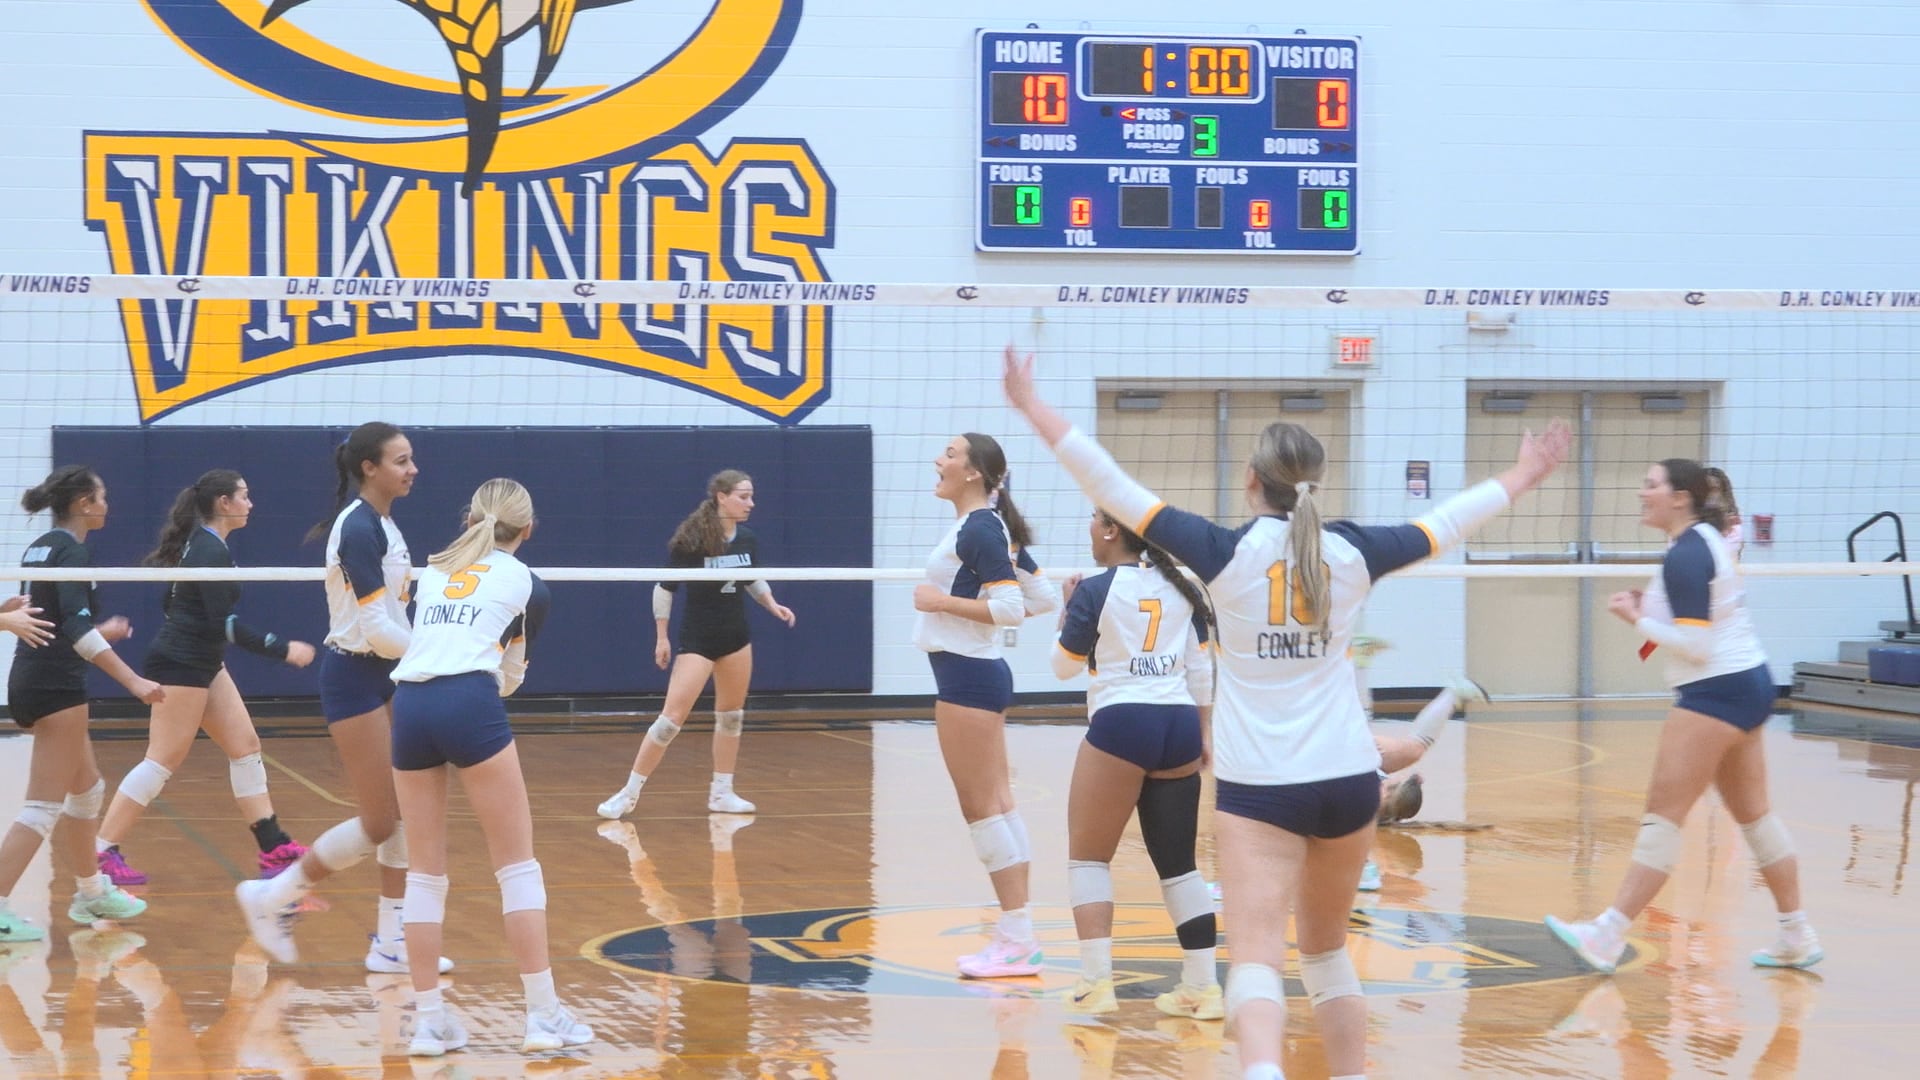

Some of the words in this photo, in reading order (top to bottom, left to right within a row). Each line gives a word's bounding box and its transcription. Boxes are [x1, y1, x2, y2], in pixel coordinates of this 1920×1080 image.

[995, 41, 1063, 64] HOME
[1266, 45, 1354, 70] VISITOR
[1142, 47, 1251, 95] 1:00
[1023, 75, 1068, 123] 10
[1317, 80, 1349, 127] 0
[1137, 108, 1171, 121] POSS
[1123, 123, 1185, 140] PERIOD
[1193, 117, 1217, 156] 3
[1020, 134, 1077, 152] BONUS
[1264, 138, 1320, 155] BONUS
[989, 165, 1042, 183] FOULS
[1108, 167, 1170, 184] PLAYER
[1196, 168, 1248, 185] FOULS
[1298, 169, 1350, 186] FOULS
[1016, 186, 1041, 225] 0
[1071, 198, 1091, 227] 0
[1250, 200, 1270, 229] 0
[1323, 190, 1348, 228] 0
[1063, 229, 1096, 246] TOL
[1243, 231, 1275, 248] TOL
[11, 275, 91, 293] VIKINGS
[104, 153, 812, 397] VIKINGS
[286, 278, 325, 295] D.H.
[333, 278, 404, 296] CONLEY
[413, 279, 490, 297] VIKINGS
[679, 282, 715, 299] D.H.
[724, 283, 794, 299] CONLEY
[801, 284, 876, 301] VIKINGS
[1058, 286, 1094, 302] D.H.
[1102, 287, 1170, 303] CONLEY
[1177, 287, 1249, 304] VIKINGS
[1425, 289, 1459, 305] D.H.
[1467, 289, 1533, 305] CONLEY
[1540, 290, 1610, 306] VIKINGS
[1780, 291, 1814, 306] D.H.
[1821, 291, 1885, 306] CONLEY
[1891, 291, 1920, 307] VIK
[1341, 338, 1371, 362] EXIT
[443, 564, 491, 599] 5
[423, 603, 482, 627] CONLEY
[1138, 599, 1162, 652] 7
[1257, 631, 1333, 659] CONLEY
[1130, 654, 1177, 676] CONLEY
